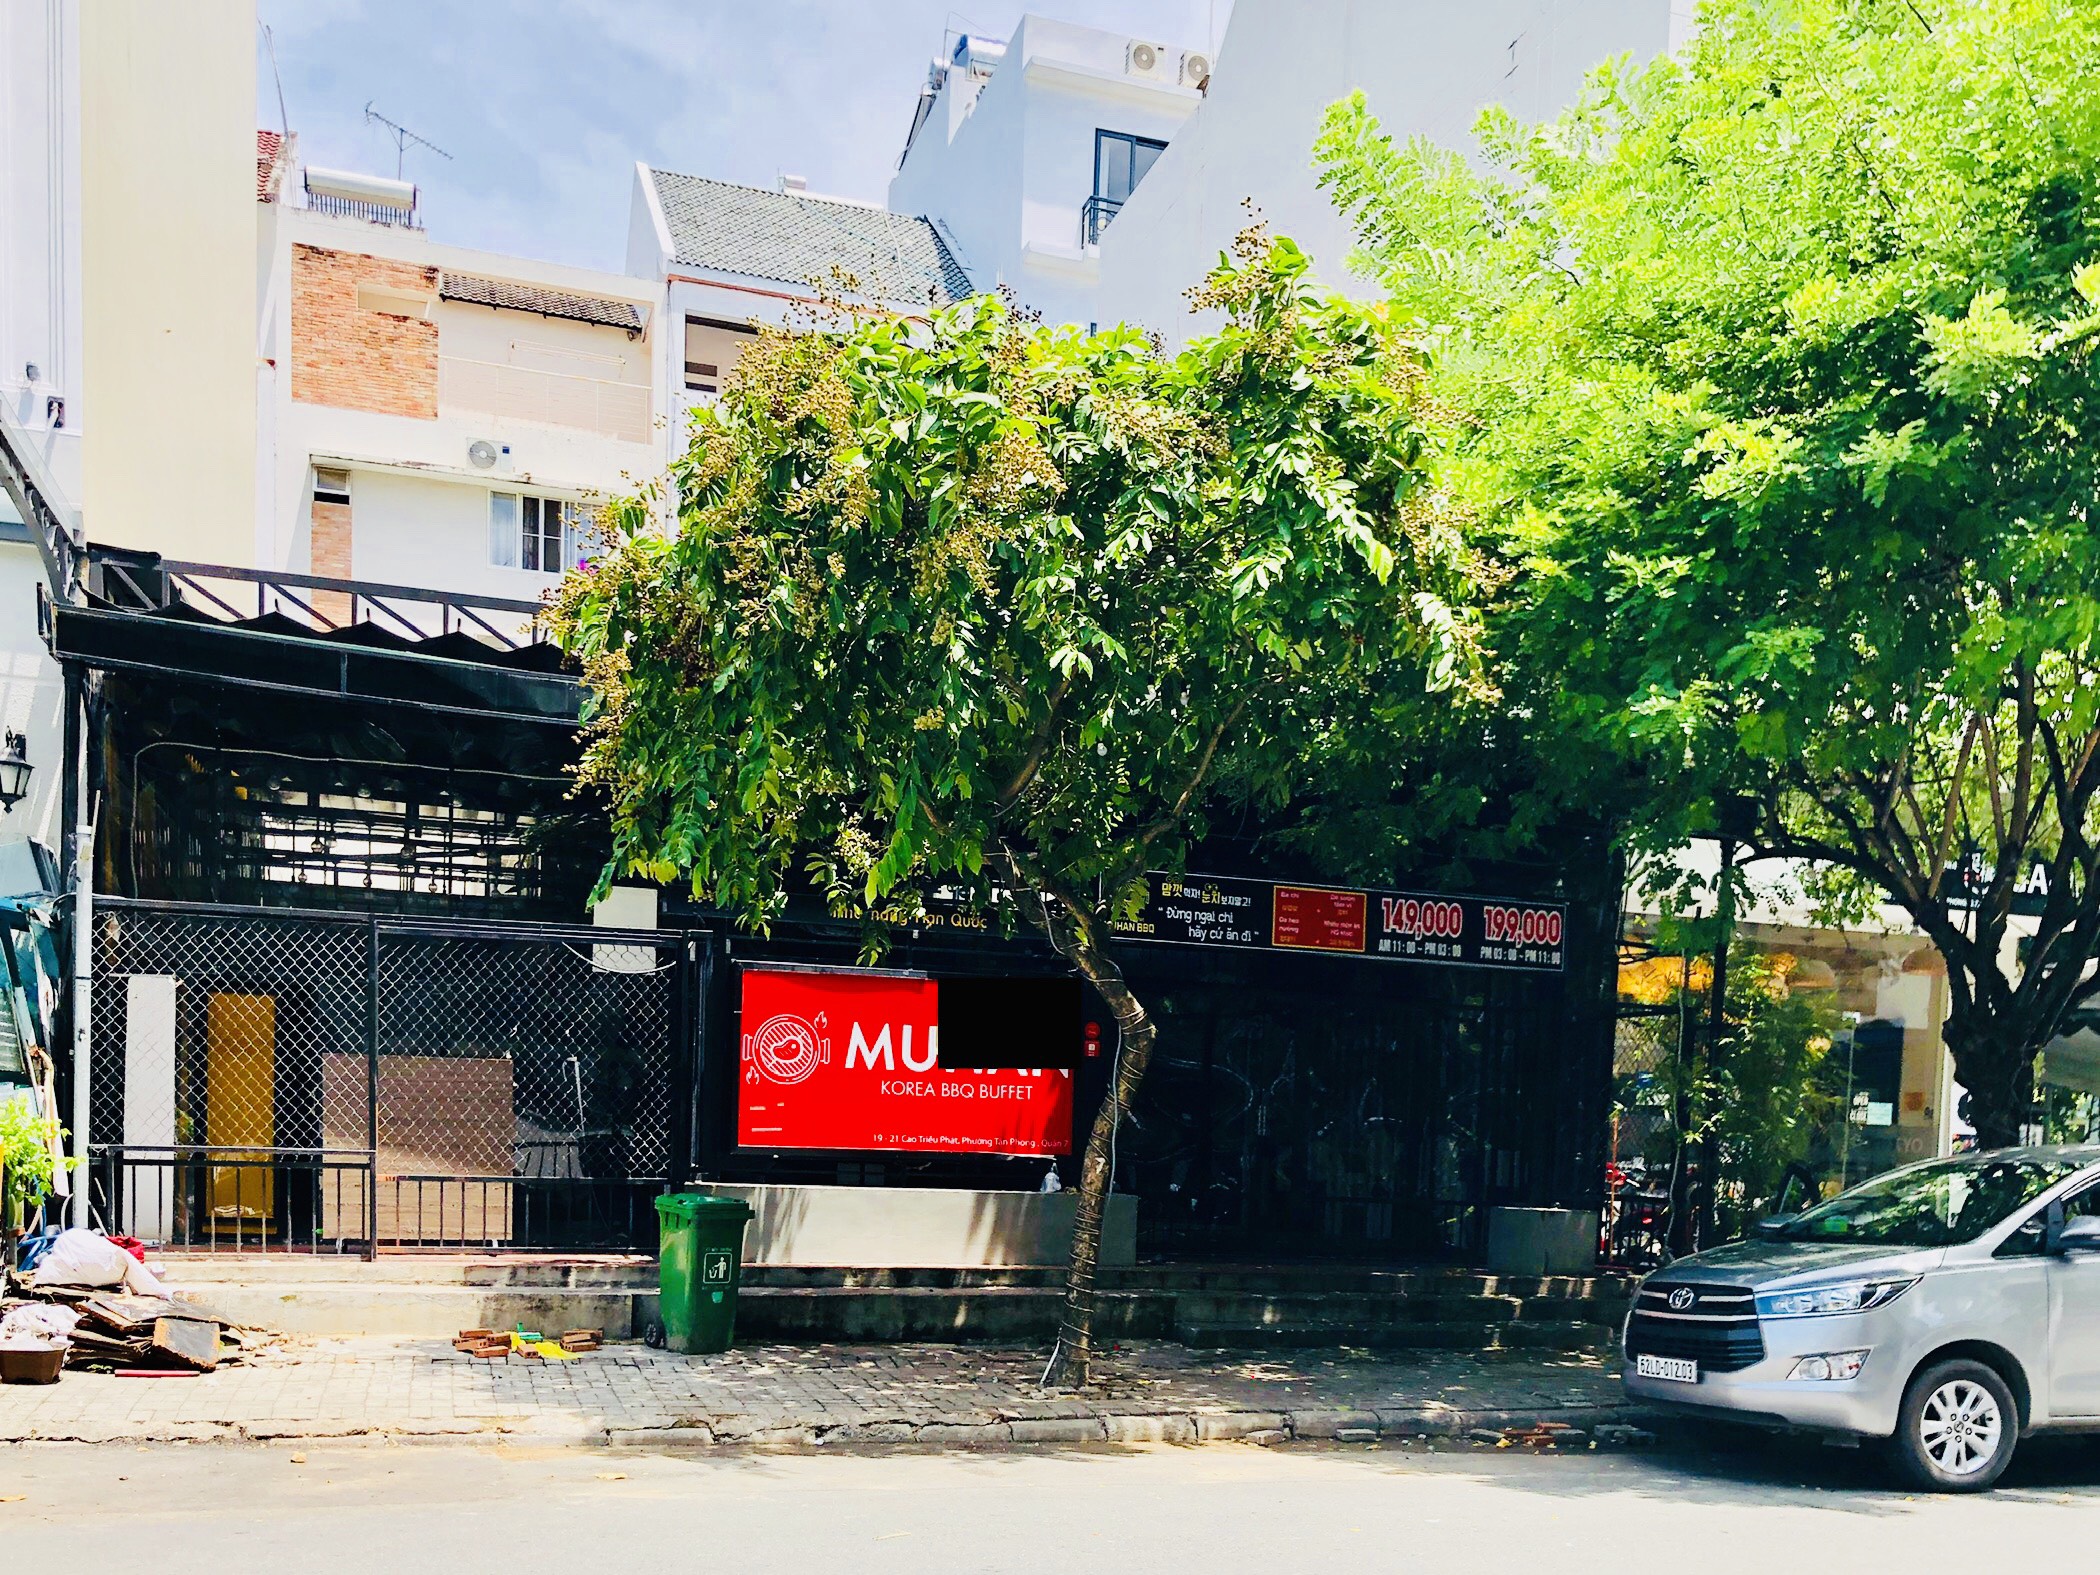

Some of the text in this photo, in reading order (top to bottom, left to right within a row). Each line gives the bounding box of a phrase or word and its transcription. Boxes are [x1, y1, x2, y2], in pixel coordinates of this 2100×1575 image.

[1382, 898, 1463, 940] 149,000
[1484, 906, 1562, 948] 199,000
[881, 1080, 1033, 1100] KOREA BBQ BUFFET
[873, 1134, 883, 1142] 19
[889, 1134, 899, 1143] 21
[901, 1134, 917, 1143] Cao
